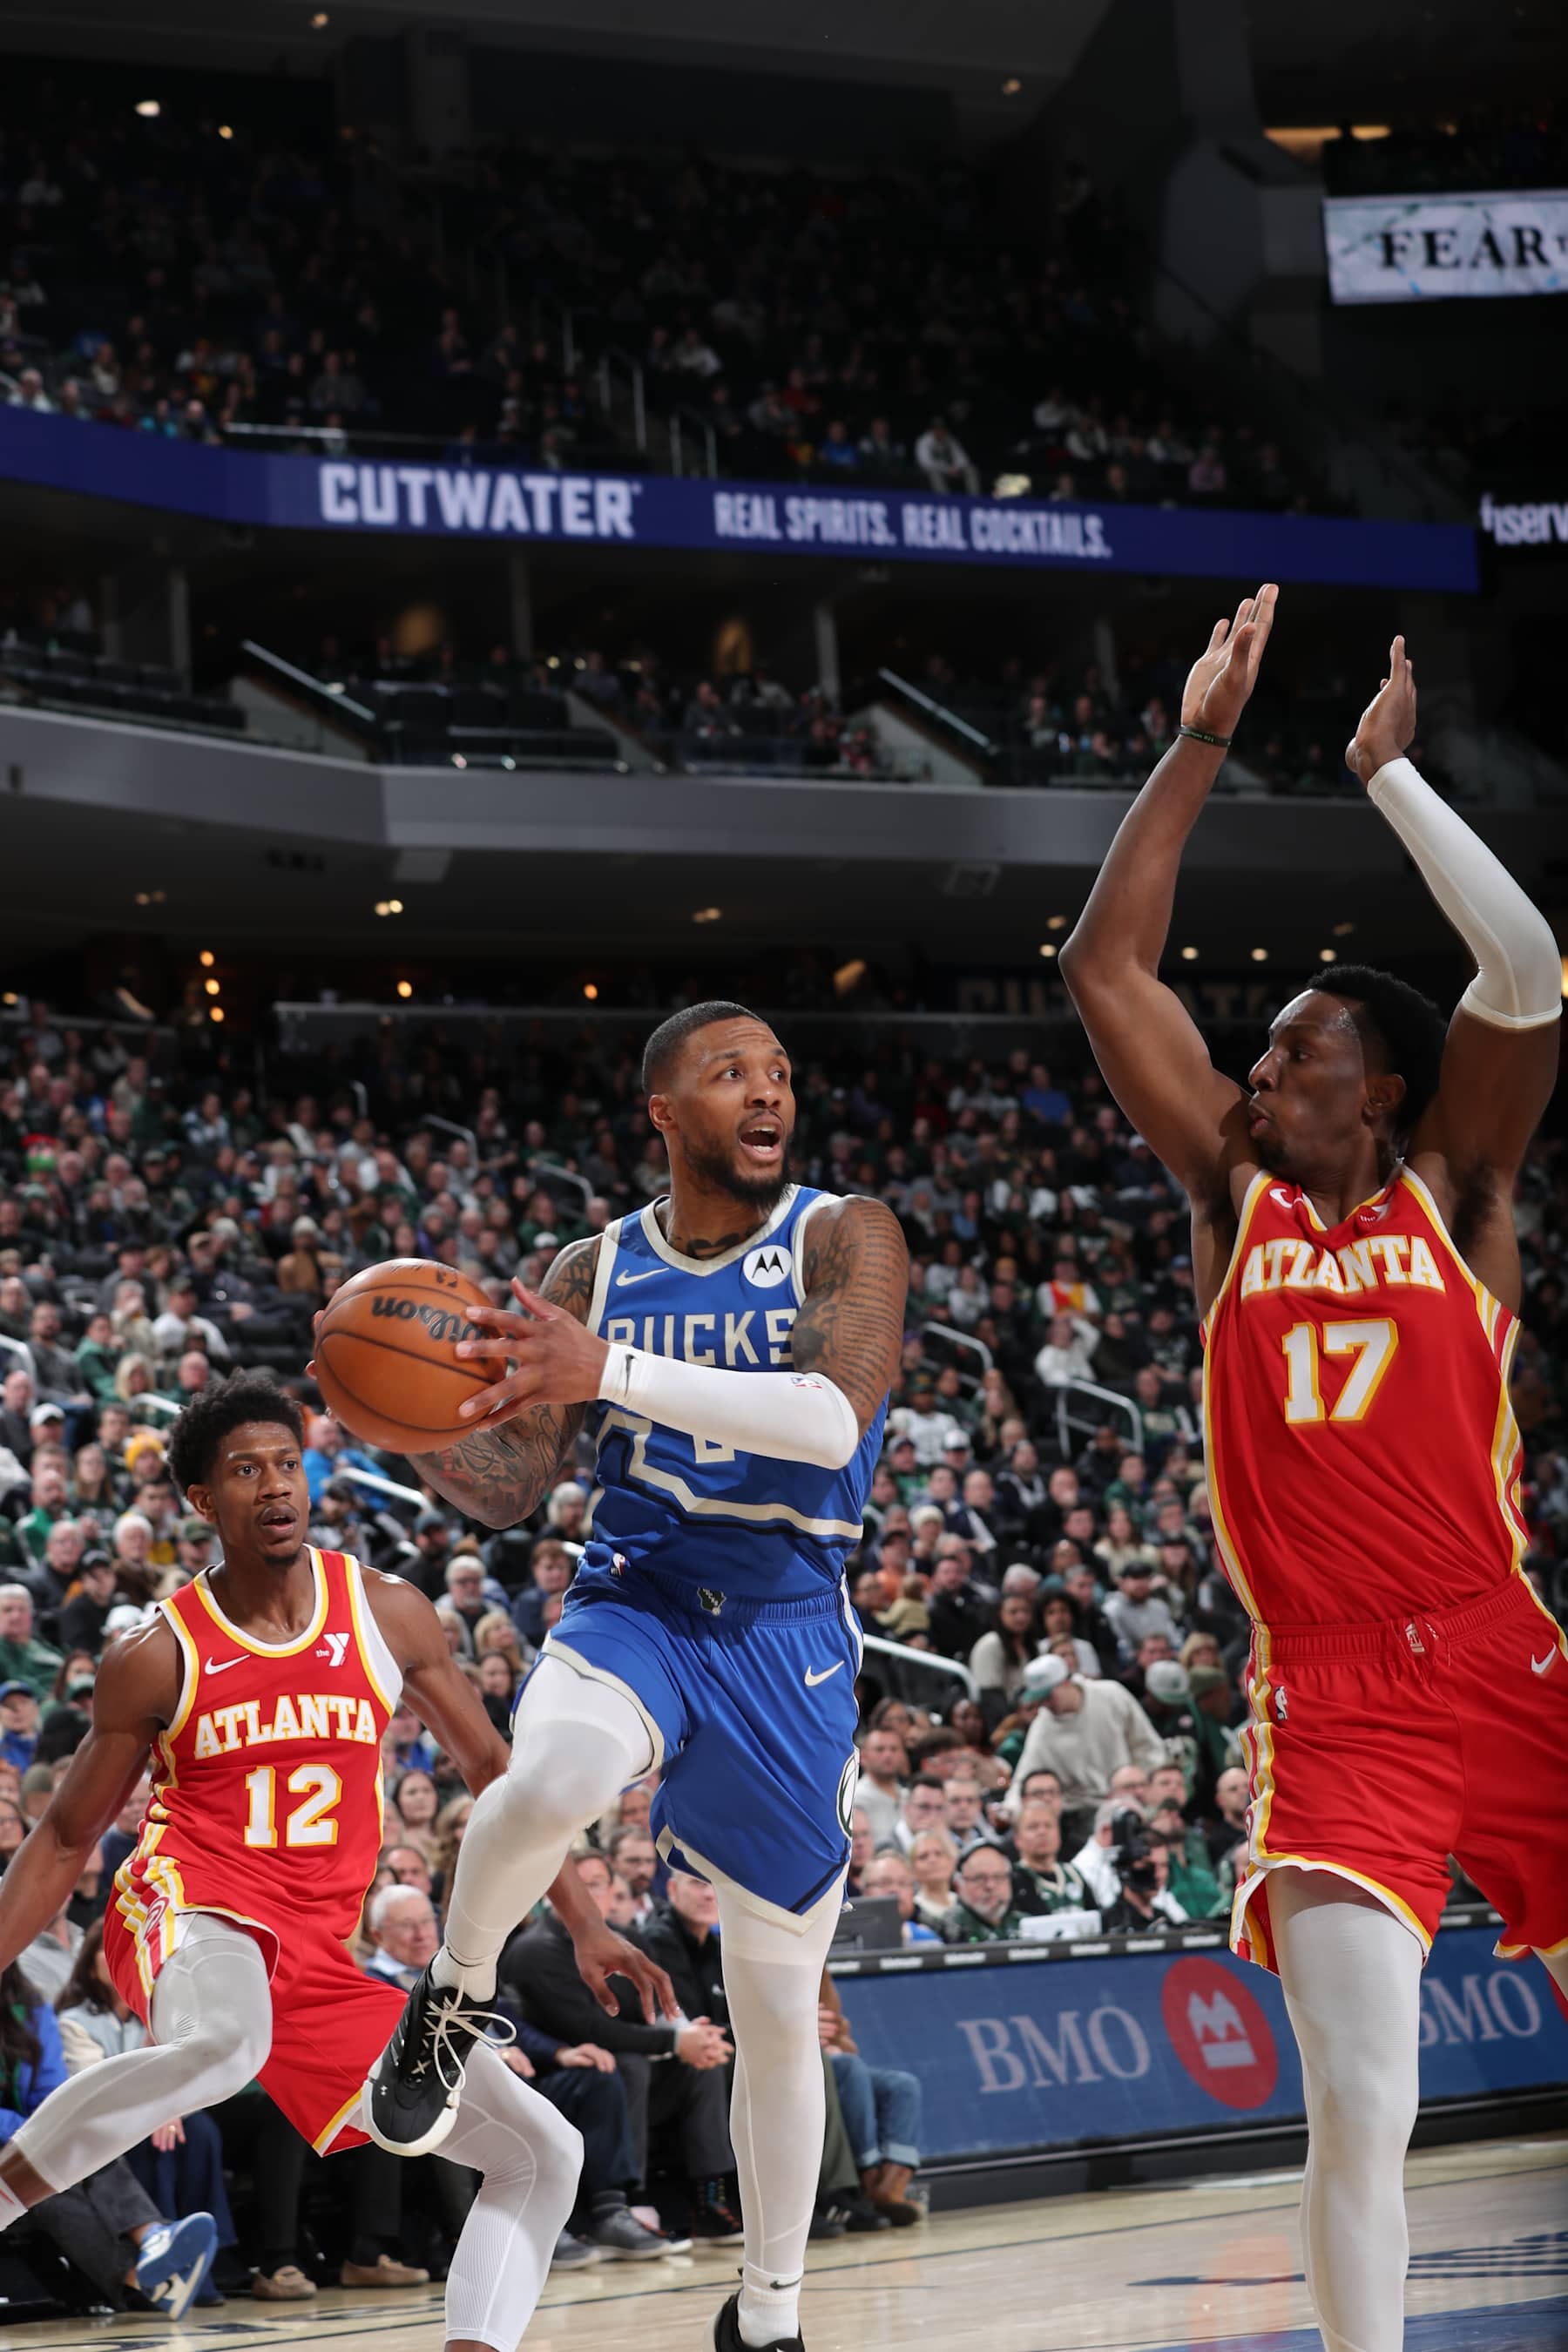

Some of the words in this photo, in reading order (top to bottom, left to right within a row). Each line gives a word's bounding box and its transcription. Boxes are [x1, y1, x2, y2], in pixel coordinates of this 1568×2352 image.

[1379, 224, 1550, 269] FEAR
[319, 462, 636, 538] CUTWATER
[713, 492, 781, 539] REAL
[786, 497, 896, 545] SPIRITS.
[902, 504, 967, 551] REAL
[970, 507, 1112, 558] COCKTAILS.
[1240, 1235, 1447, 1303] ATLANTA
[1281, 1317, 1399, 1423] 17
[193, 1694, 377, 1761] ATLANTA
[245, 1763, 343, 1848] 12
[956, 2006, 1151, 2093] BMO
